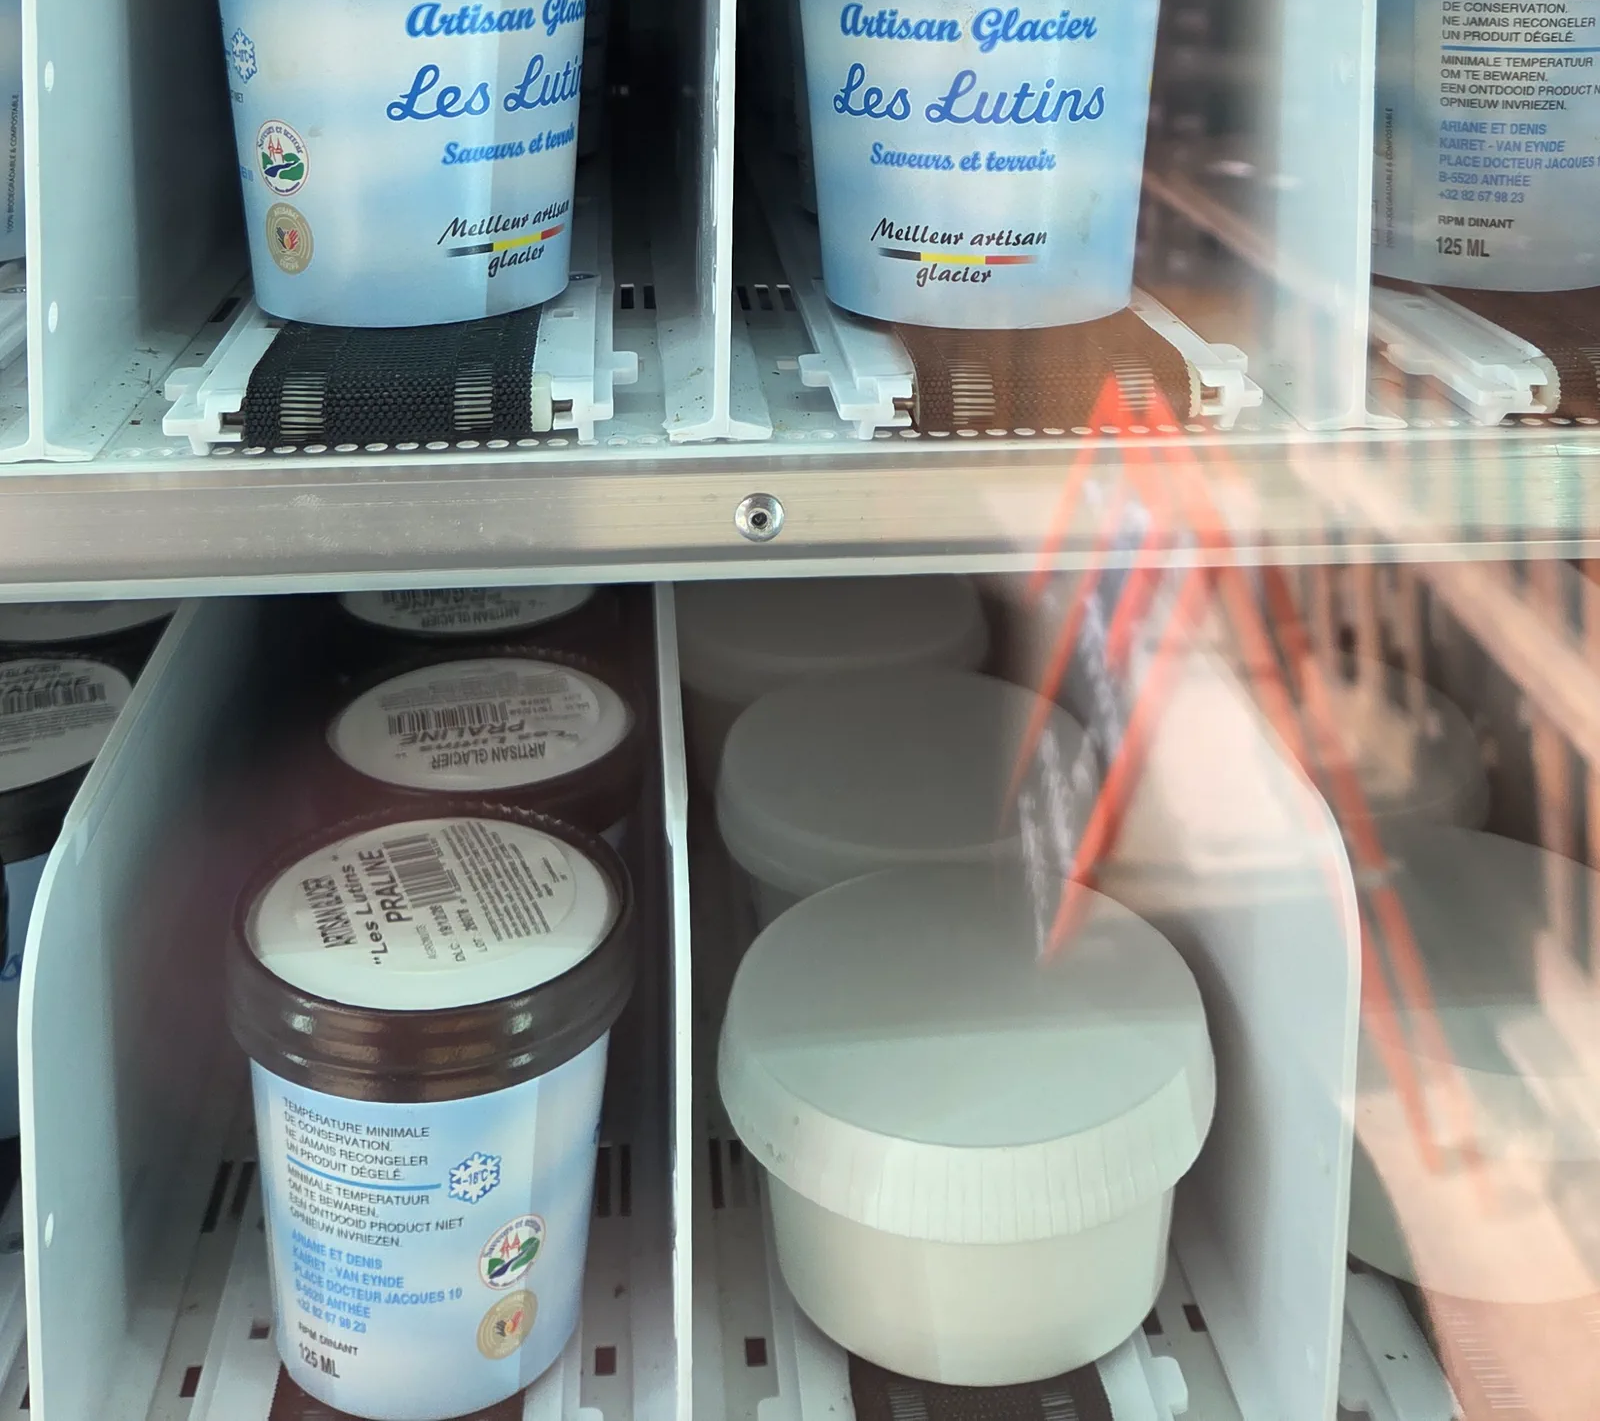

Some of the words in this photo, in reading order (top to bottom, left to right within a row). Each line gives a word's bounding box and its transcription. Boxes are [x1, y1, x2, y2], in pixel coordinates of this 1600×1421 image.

[405, 2, 535, 38] Artisan
[1442, 16, 1459, 25] NE
[1463, 17, 1509, 27] JAMAIS
[1513, 18, 1595, 27] RECONGELER
[1443, 2, 1460, 11] DE
[1464, 2, 1567, 13] CONSERVATION.
[840, 2, 962, 42] Artisan
[971, 7, 1097, 53] Glacier
[1442, 31, 1459, 40] UN
[1463, 31, 1520, 42] PRODUIT
[1524, 31, 1575, 42] DÉGELÉ.
[1441, 55, 1502, 67] MINIMALE
[1504, 57, 1593, 67] TEMPERATUUR
[1441, 69, 1460, 79] OM
[1464, 70, 1480, 79] TE
[1483, 71, 1548, 81] BEWAREN.
[386, 64, 491, 121] Les
[833, 62, 911, 122] Les
[924, 69, 1105, 124] Lutins
[1440, 97, 1499, 108] OPNIEUW
[1502, 100, 1567, 110] INVRIEZEN.
[1441, 83, 1465, 93] EEN
[1469, 85, 1535, 96] ONTDOOID
[1538, 85, 1591, 95] PRODUCT
[1440, 120, 1487, 134] ARIANE
[1491, 123, 1506, 134] ET
[1510, 124, 1547, 135] DENIS
[442, 141, 525, 166] Saveurs
[528, 132, 544, 154] et
[870, 141, 955, 170] Saveurs
[959, 150, 981, 171] et
[985, 147, 1056, 172] terroir
[1440, 138, 1485, 150] KAIRET
[1496, 140, 1521, 152] VAN
[1525, 141, 1565, 152] EYNDE
[1439, 154, 1481, 167] PLACE
[1483, 157, 1542, 169] DOCTEUR
[1545, 157, 1594, 169] JACQUES
[1481, 172, 1531, 186] ANTHÉE
[1461, 190, 1474, 201] 82
[1510, 192, 1524, 203] 23
[437, 214, 529, 245] Meilleur
[532, 199, 570, 225] artisan
[870, 217, 963, 246] Meilleur
[970, 229, 1048, 246] artisan
[1438, 215, 1464, 226] RPM
[1468, 217, 1514, 229] DINANT
[488, 245, 544, 278] glacier
[1436, 237, 1462, 255] 125
[1467, 239, 1490, 257] ML
[916, 263, 991, 287] glacier
[431, 746, 488, 770] GLACIER
[491, 741, 547, 762] ARTISAN
[358, 849, 413, 923] PRALINE
[283, 1097, 362, 1134] TEMPÉRATURE
[366, 1126, 430, 1137] MINIMALE
[284, 1111, 295, 1123] DE
[298, 1119, 392, 1151] CONSERVATION.
[285, 1125, 297, 1138] NE
[300, 1133, 336, 1156] JAMAIS
[340, 1149, 427, 1166] RECONGELER
[286, 1139, 298, 1155] UN
[300, 1148, 348, 1173] PRODUIT
[351, 1165, 405, 1179] DÉGELÉ.
[288, 1164, 332, 1194] MINIMALE
[337, 1186, 429, 1205] TEMPERATUUR
[289, 1179, 300, 1193] OM
[304, 1188, 316, 1200] TE
[319, 1194, 379, 1218] BEWAREN.
[289, 1193, 306, 1208] EEN
[309, 1202, 366, 1229] ONTDOOID
[370, 1221, 432, 1233] PRODUCT
[435, 1217, 464, 1230] NIET
[290, 1206, 334, 1234] OPNIEUW
[337, 1229, 402, 1247] INVRIEZEN.
[292, 1230, 326, 1256] ARIANE
[330, 1247, 342, 1261] ET
[346, 1253, 382, 1269] DENIS
[294, 1262, 324, 1288] PLACE
[327, 1279, 382, 1303] DOCTEUR
[385, 1290, 445, 1305] JACQUES
[335, 1266, 359, 1282] VAN
[363, 1274, 404, 1288] EYNDE
[327, 1296, 371, 1318] ANTHÉE
[299, 1343, 318, 1367] 125
[320, 1355, 340, 1378] ML
